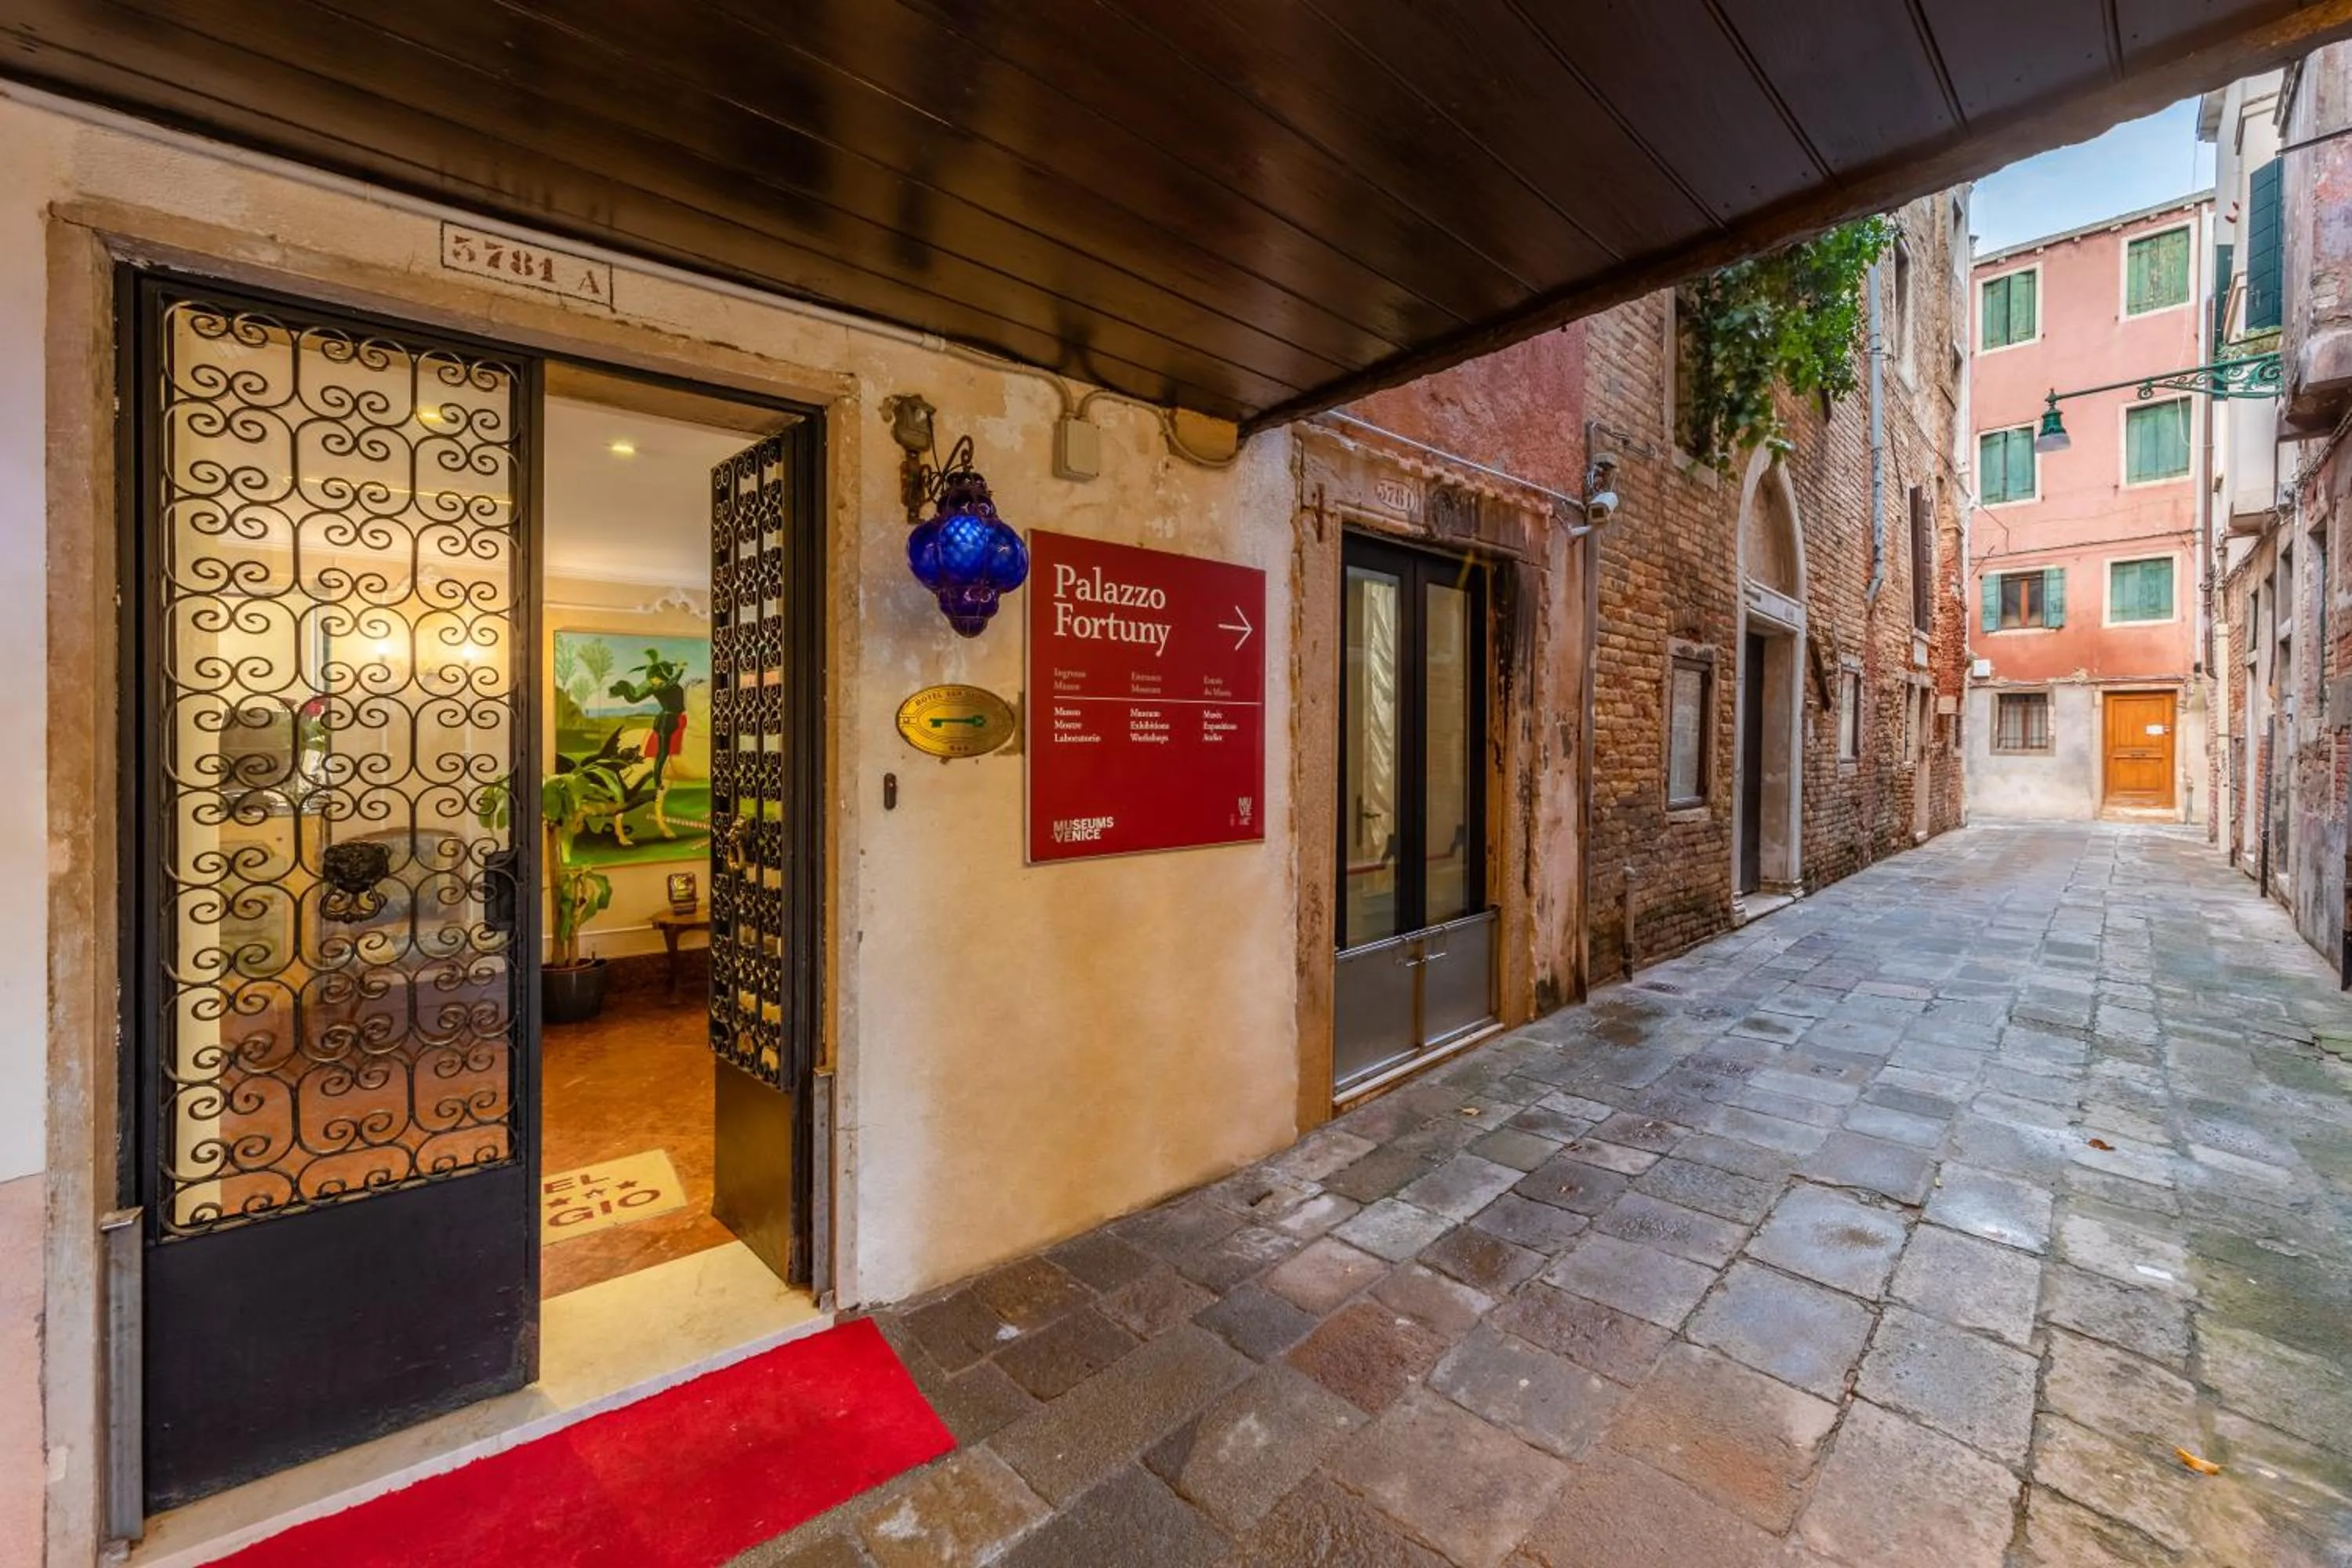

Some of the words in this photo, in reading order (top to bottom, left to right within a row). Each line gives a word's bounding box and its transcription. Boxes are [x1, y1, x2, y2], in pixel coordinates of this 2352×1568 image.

[452, 235, 555, 283] 5781
[578, 270, 602, 295] A
[1053, 564, 1167, 610] Palazzo
[1053, 602, 1172, 657] Fortuny
[1053, 816, 1114, 832] MUSEUMS
[1054, 829, 1102, 843] VENICE
[547, 1189, 662, 1227] GIO
